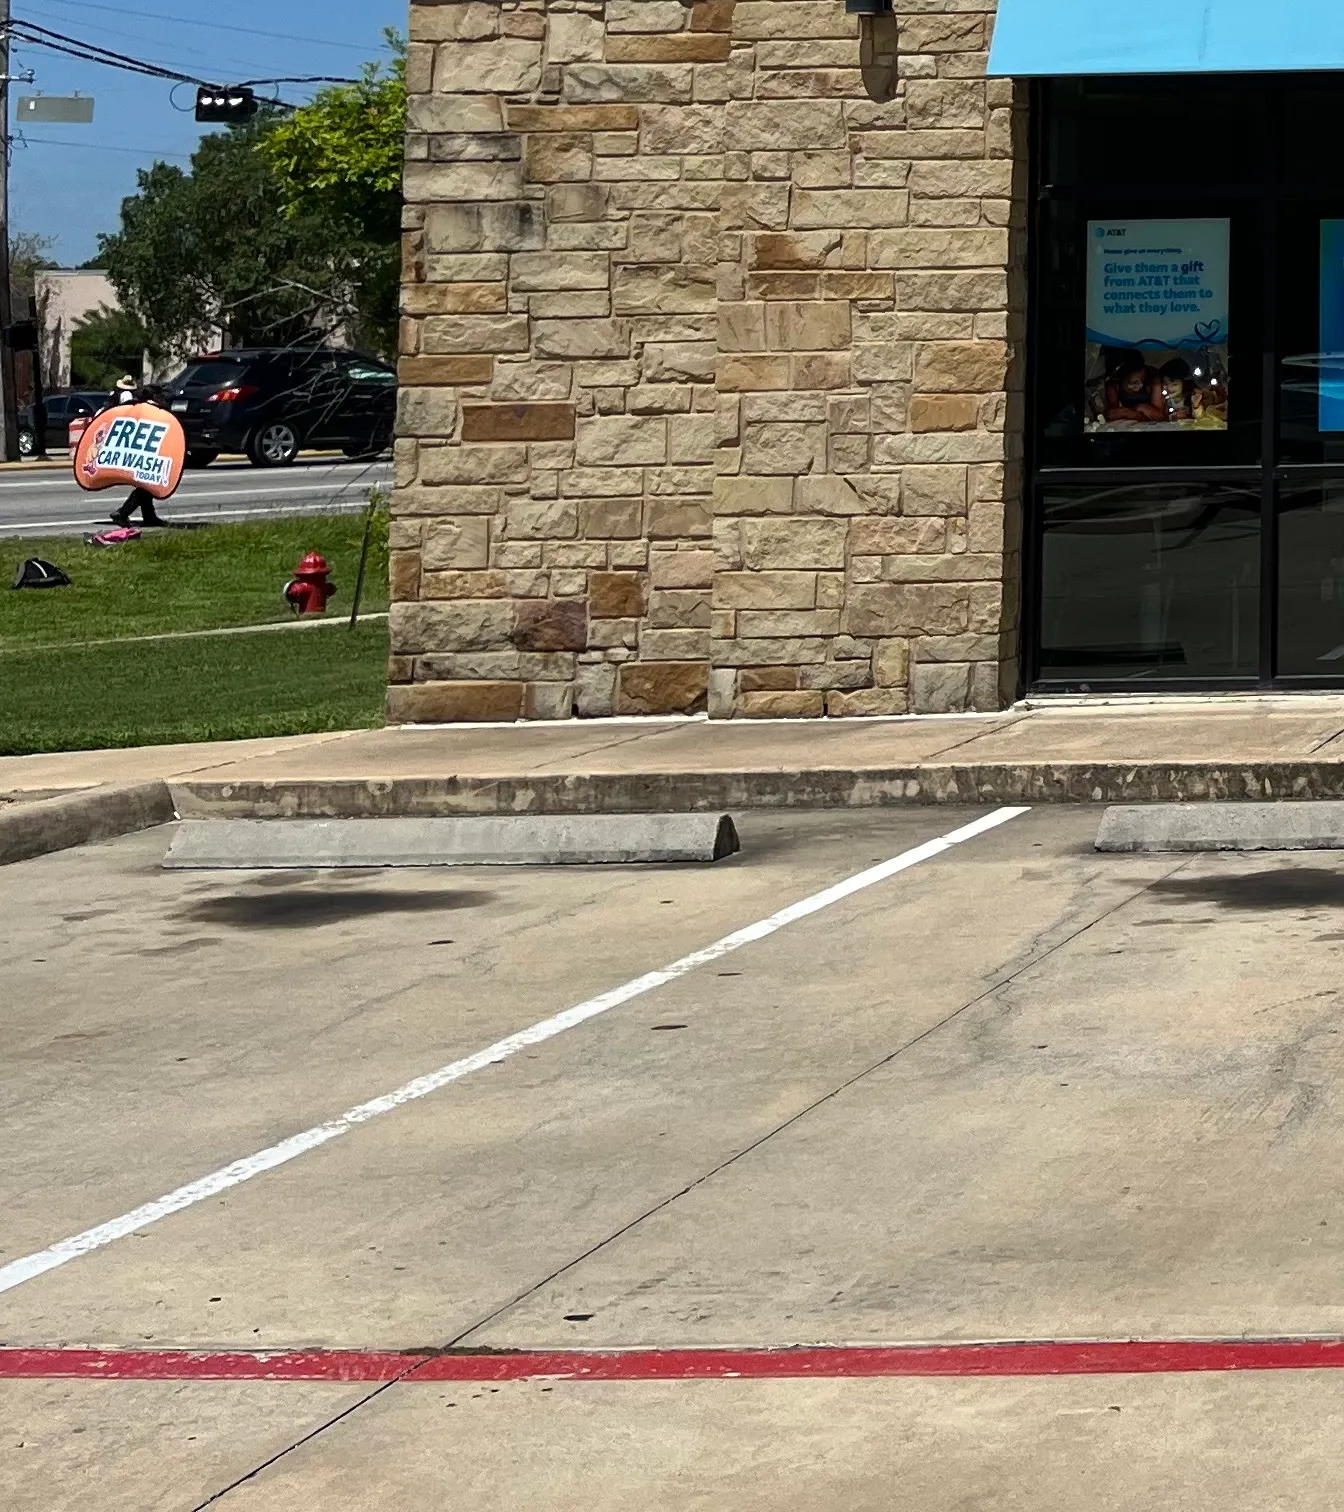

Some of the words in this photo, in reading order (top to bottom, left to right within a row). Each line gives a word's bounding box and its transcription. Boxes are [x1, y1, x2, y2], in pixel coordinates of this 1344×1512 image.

[1106, 228, 1127, 237] AT&T
[1104, 262, 1132, 274] Give
[1134, 261, 1169, 273] them
[1170, 263, 1179, 272] a
[1180, 260, 1205, 275] gift
[1103, 276, 1135, 287] from
[1138, 275, 1171, 286] AT&T
[1172, 274, 1200, 286] that
[1103, 289, 1161, 301] connects
[1163, 288, 1197, 299] them
[1199, 289, 1214, 298] to
[1103, 303, 1136, 314] what
[1139, 302, 1168, 316] they
[1171, 301, 1201, 313] love.
[105, 420, 166, 453] FREE
[97, 450, 121, 466] CAR
[122, 452, 164, 473] WASH
